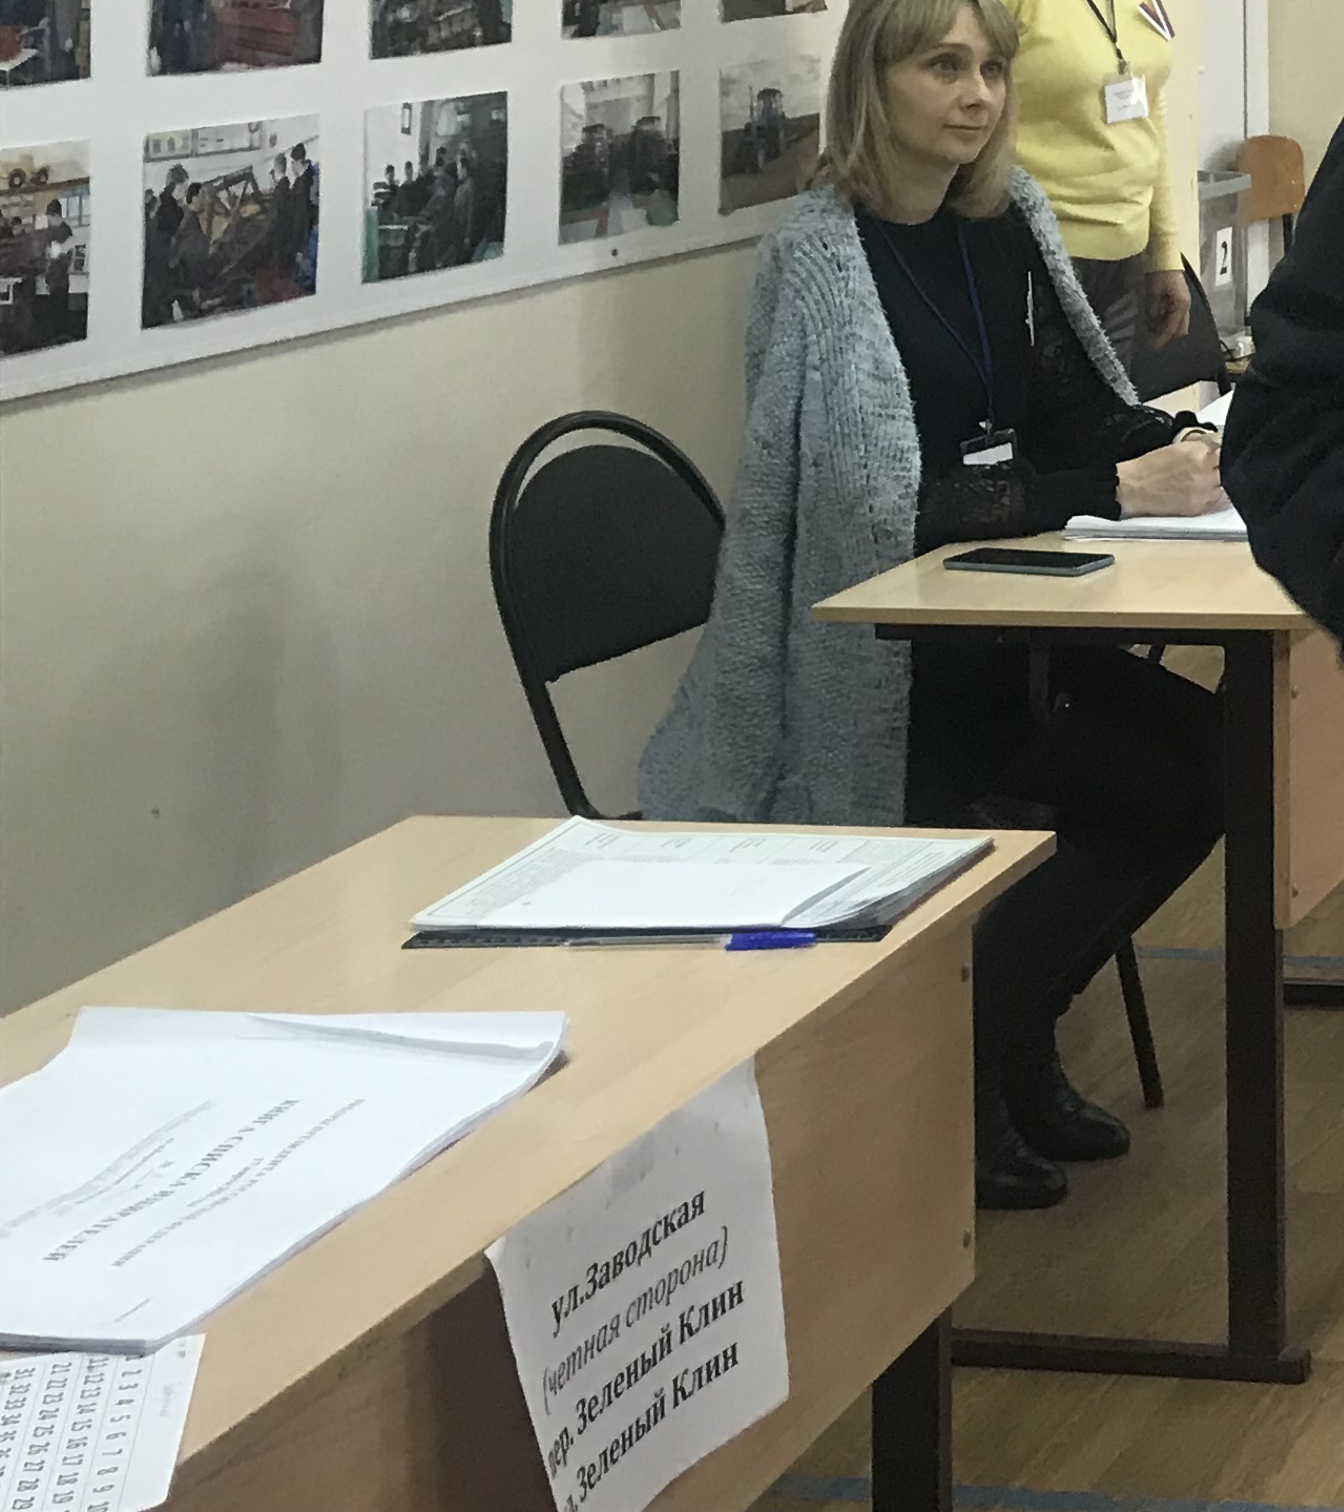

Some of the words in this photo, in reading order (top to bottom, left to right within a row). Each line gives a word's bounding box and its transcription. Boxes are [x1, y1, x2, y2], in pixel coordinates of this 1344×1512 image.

[1220, 241, 1228, 275] 2
[551, 1190, 706, 1338] ул.Заводская
[542, 1313, 621, 1416] (четная
[626, 1225, 729, 1329] сторона)
[576, 1322, 672, 1435] Зеленый
[679, 1281, 744, 1345] Клин
[13, 1367, 36, 1380] 31
[50, 1362, 72, 1375] 21
[122, 1369, 142, 1377] 2
[46, 1377, 68, 1390] 22
[83, 1373, 105, 1385] 12
[9, 1383, 31, 1396] 32
[80, 1387, 101, 1399] 13
[119, 1383, 139, 1391] 3
[4, 1397, 27, 1410] 33
[43, 1392, 64, 1405] 23
[38, 1407, 60, 1420] 24
[76, 1402, 97, 1415] 14
[71, 1419, 93, 1432] 15
[110, 1415, 131, 1423] 5
[576, 1386, 667, 1502] Зеленый
[672, 1342, 739, 1410] Клин
[33, 1424, 55, 1438] 25
[106, 1432, 127, 1440] 6
[27, 1442, 50, 1456] 26
[66, 1436, 88, 1450] 16
[102, 1448, 123, 1456] 7
[22, 1460, 45, 1472] 27
[62, 1454, 84, 1466] 17
[97, 1467, 118, 1476] 8
[17, 1478, 40, 1492] 28
[57, 1472, 79, 1486] 18
[93, 1484, 114, 1494] 9
[12, 1496, 35, 1511] 29
[52, 1490, 74, 1504] 19
